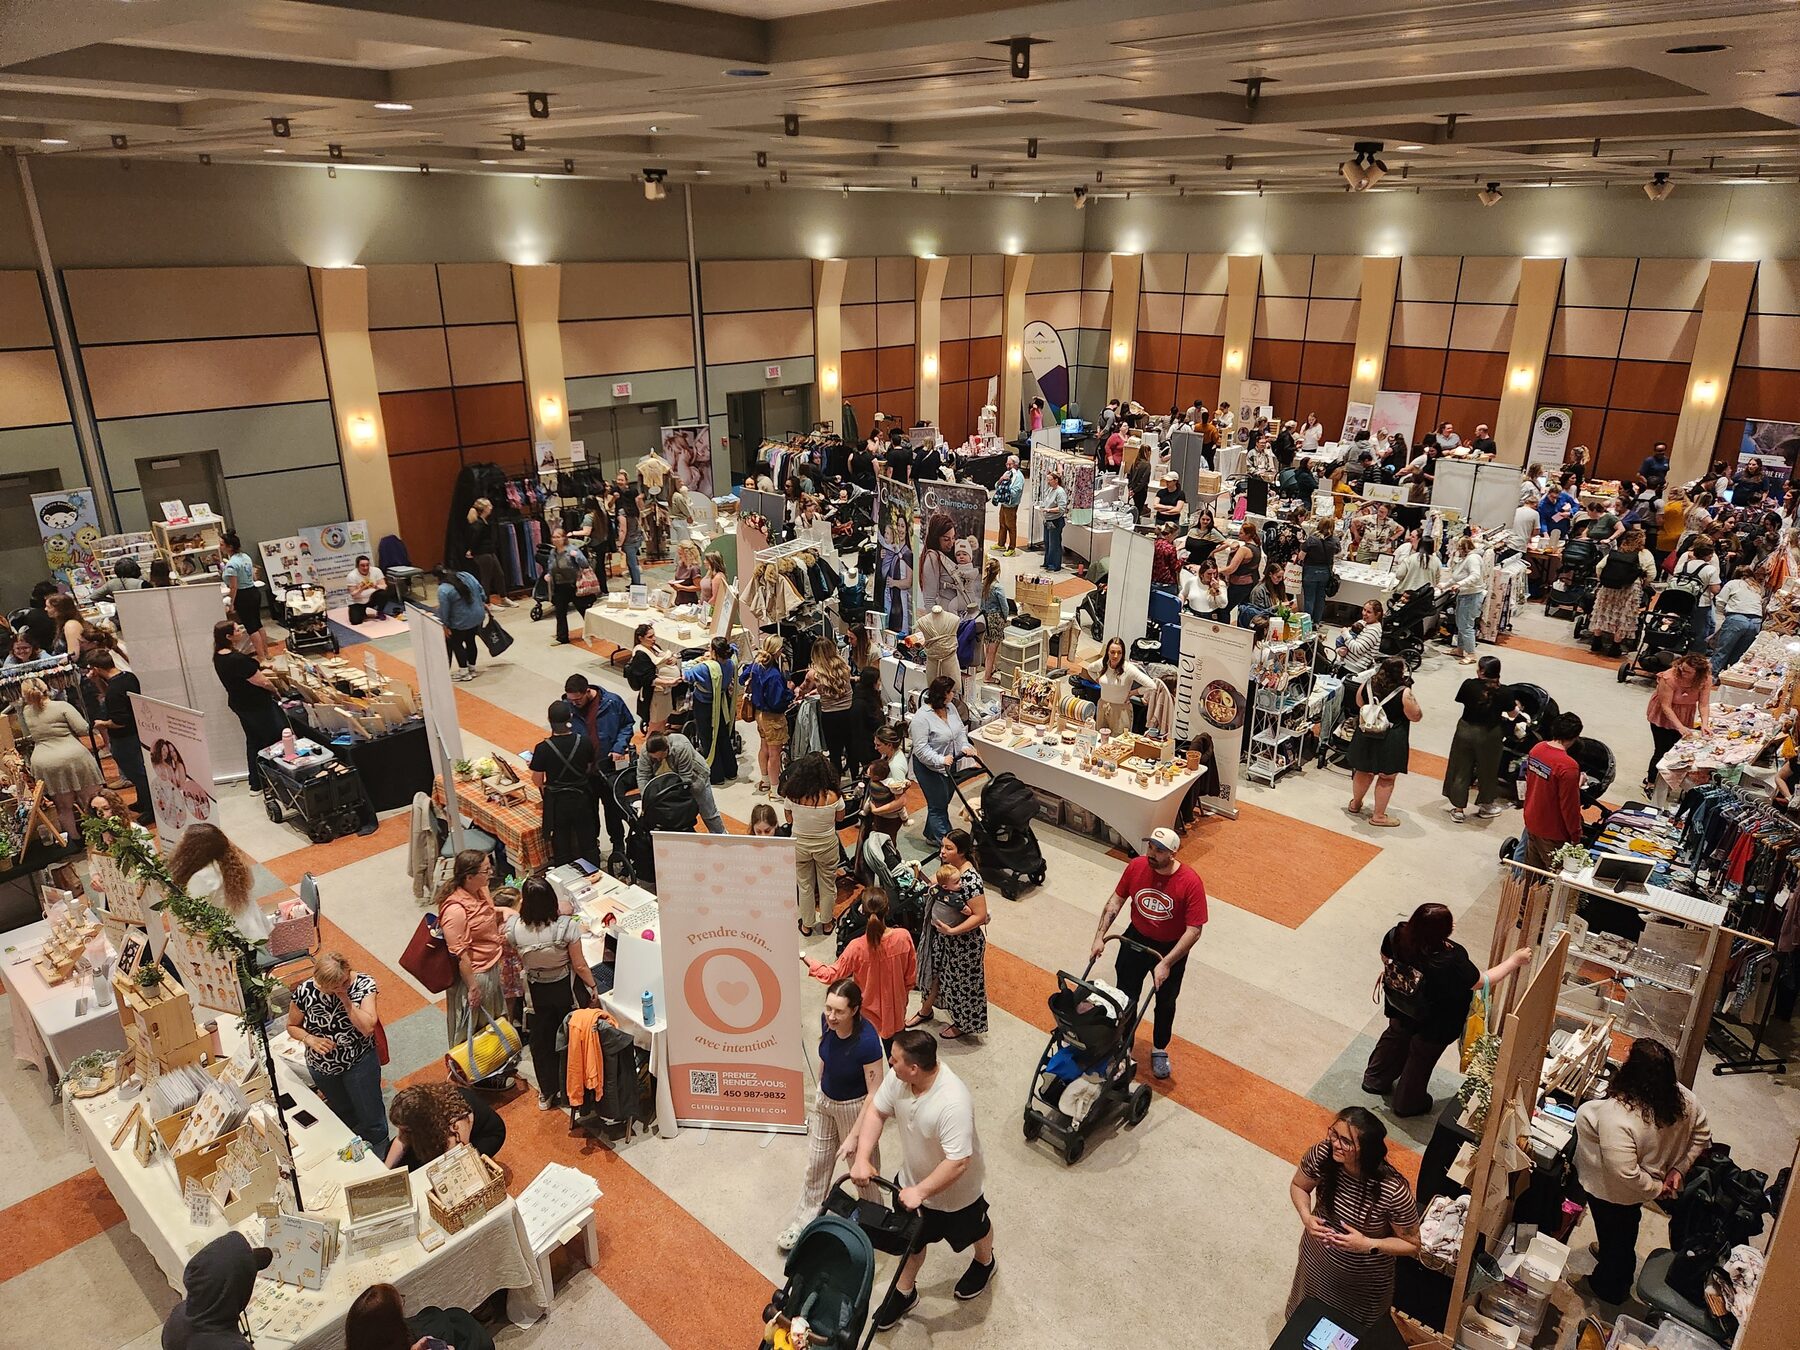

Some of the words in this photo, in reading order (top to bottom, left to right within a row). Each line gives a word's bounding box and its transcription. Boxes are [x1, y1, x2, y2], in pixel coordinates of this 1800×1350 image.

[939, 498, 978, 510] Chimparoo
[1175, 651, 1196, 741] aramel
[686, 925, 738, 945] Prendre
[740, 933, 772, 953] soin...
[694, 1035, 720, 1050] avec
[722, 1034, 778, 1053] intention!
[722, 1071, 757, 1080] PRENEZ
[722, 1079, 787, 1089] RENDEZ-VOUS:
[723, 1090, 742, 1098] 450
[743, 1090, 786, 1100] 987-9832
[690, 1103, 787, 1115] CLINIQUEORIGINE.COM
